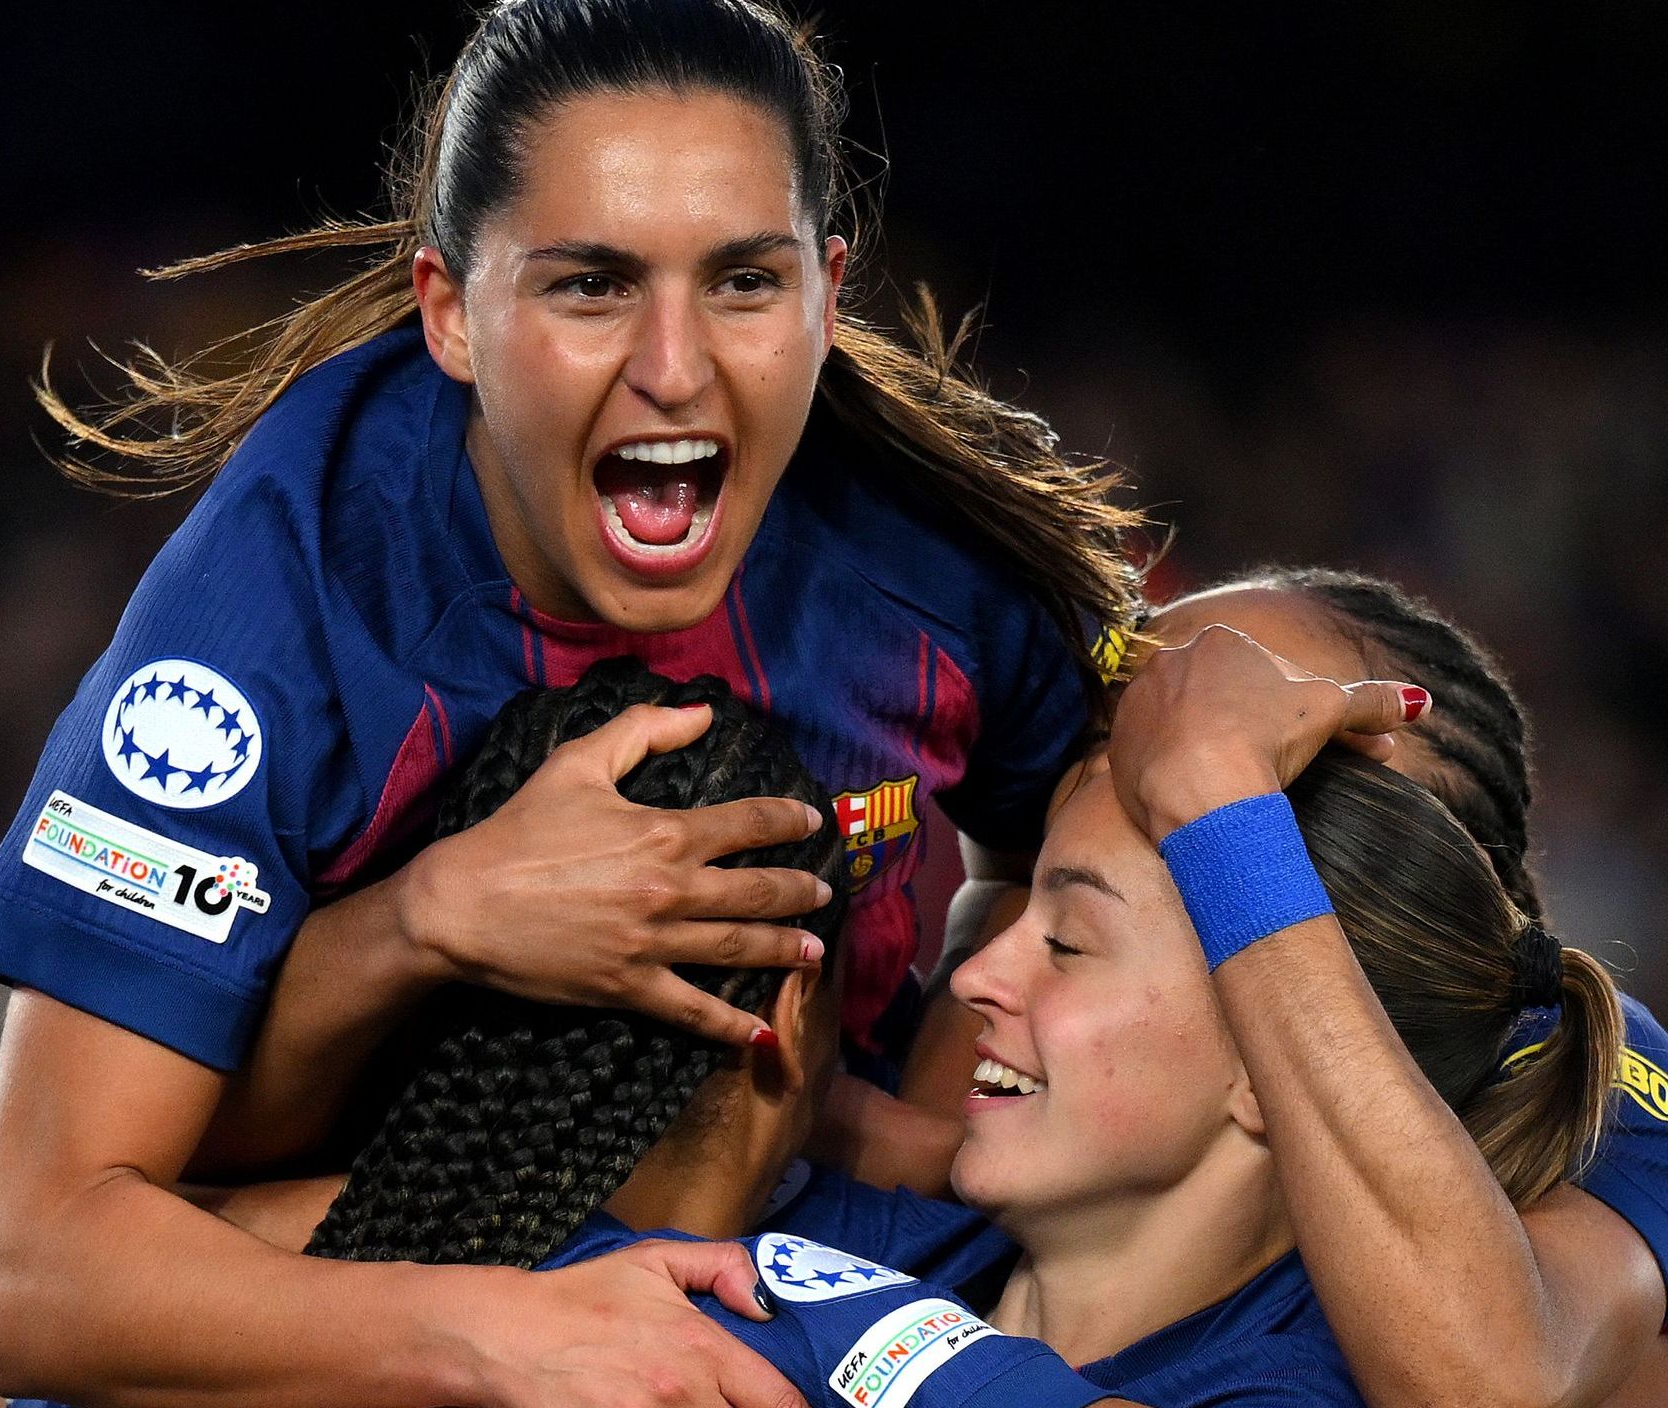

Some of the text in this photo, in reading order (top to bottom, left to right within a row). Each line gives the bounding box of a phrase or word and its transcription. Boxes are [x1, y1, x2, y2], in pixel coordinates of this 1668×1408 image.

[48, 797, 73, 817] UEFA
[36, 818, 167, 889] FOUNDATION
[95, 879, 156, 911] for children
[172, 864, 232, 916] 10
[235, 890, 265, 908] YEARS
[946, 1336, 960, 1350] for
[837, 1351, 868, 1390] UEFA
